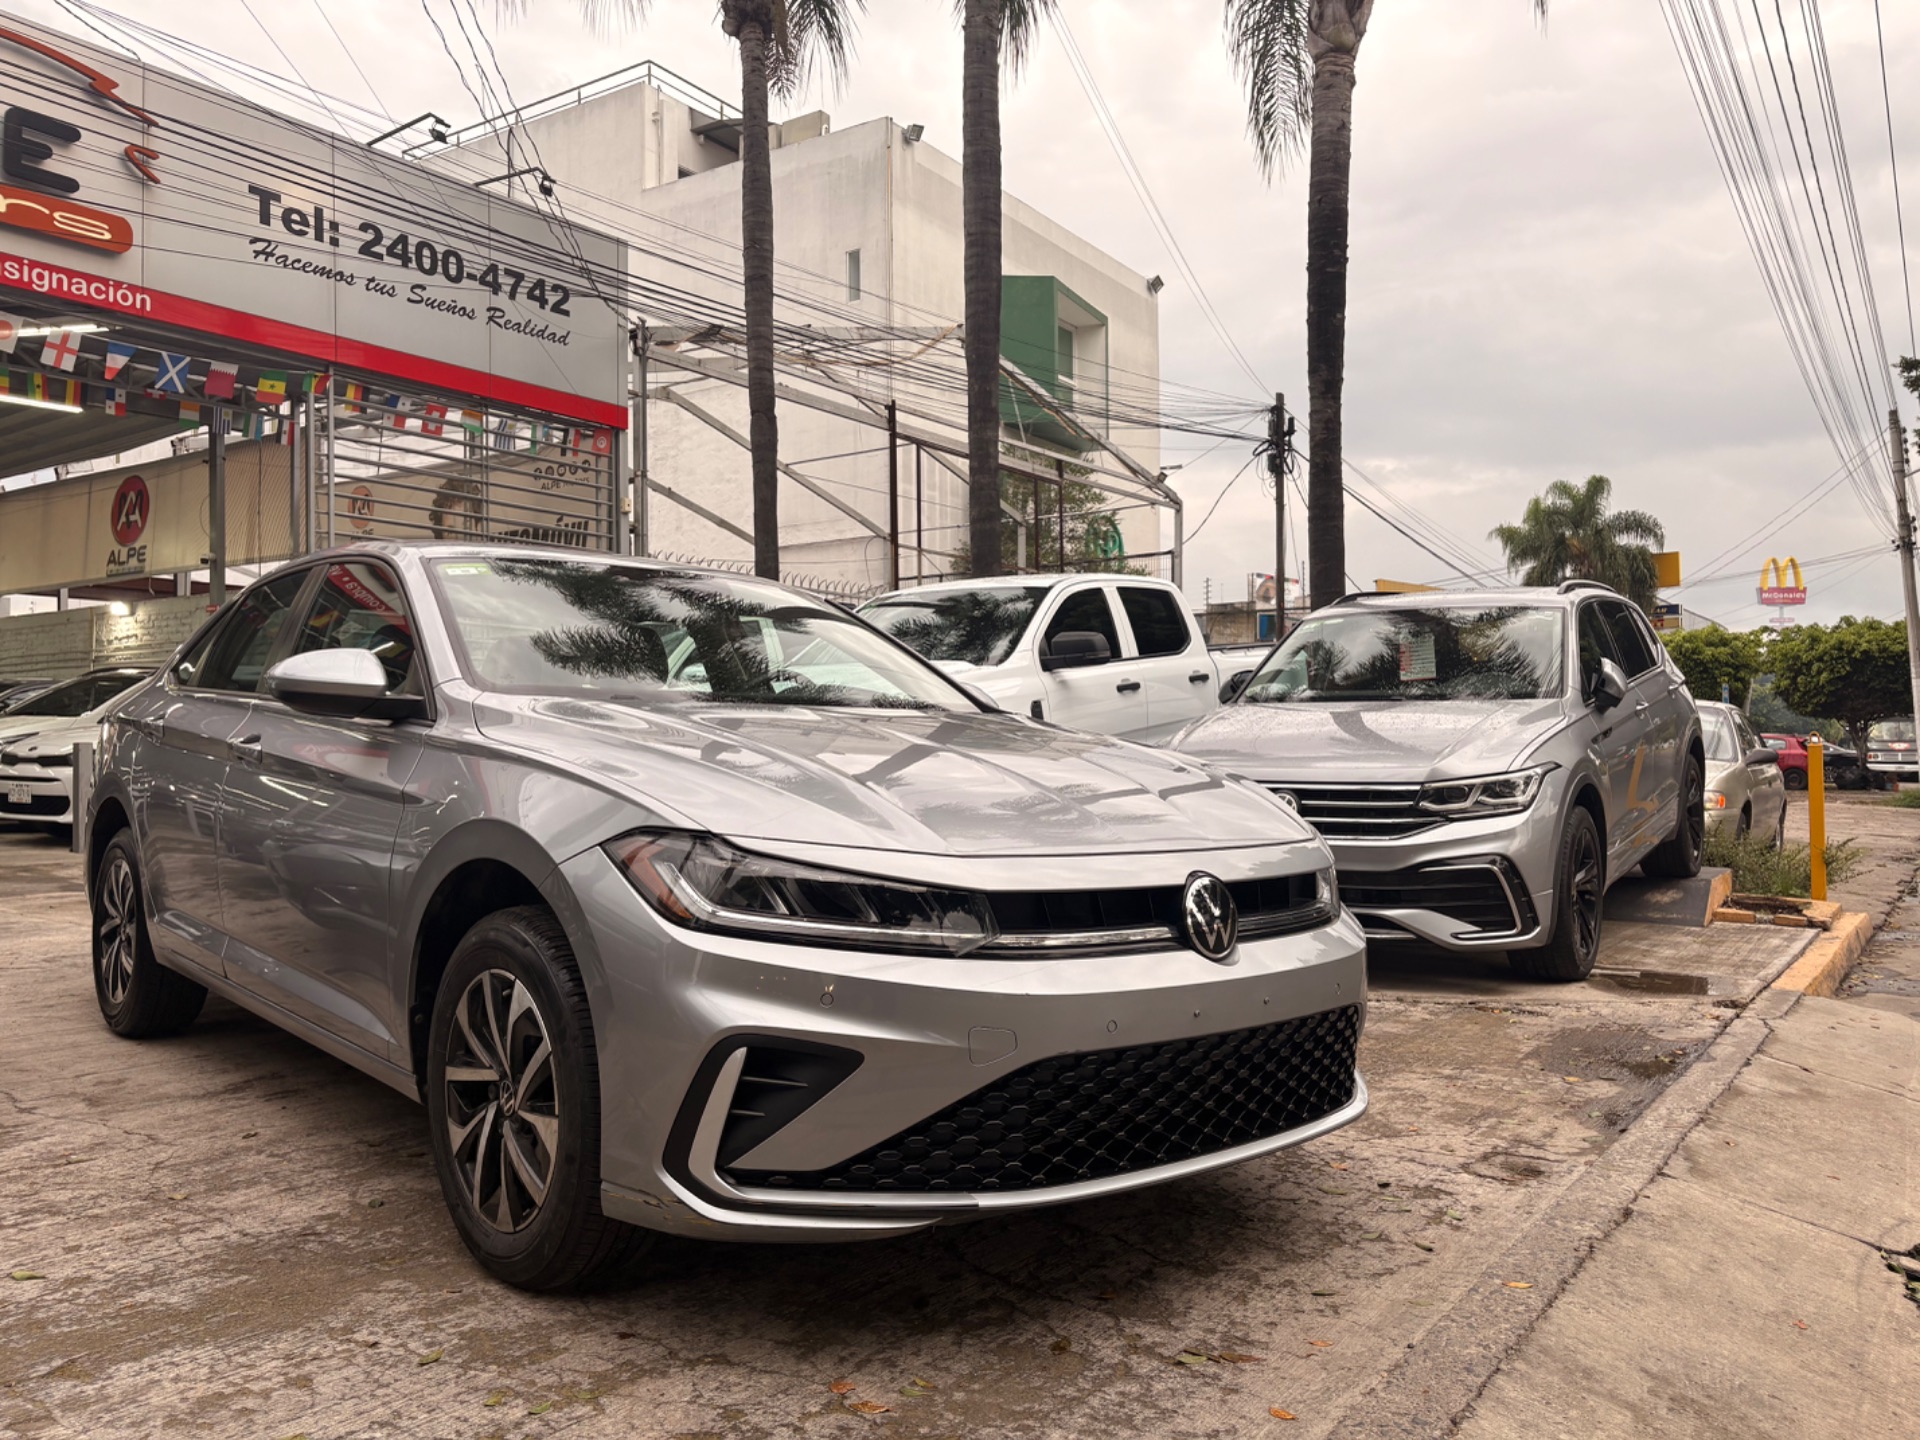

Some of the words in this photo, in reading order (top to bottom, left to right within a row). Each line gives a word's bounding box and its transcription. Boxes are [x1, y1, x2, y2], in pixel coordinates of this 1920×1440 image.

[0, 258, 152, 312] signación
[248, 184, 340, 248] Tel:
[358, 221, 571, 318] 2400-4742
[248, 238, 356, 286] Hacemos
[365, 273, 398, 299] tus
[406, 284, 478, 322] Sueños
[486, 305, 571, 347] Realidad
[106, 544, 148, 568] ALPE
